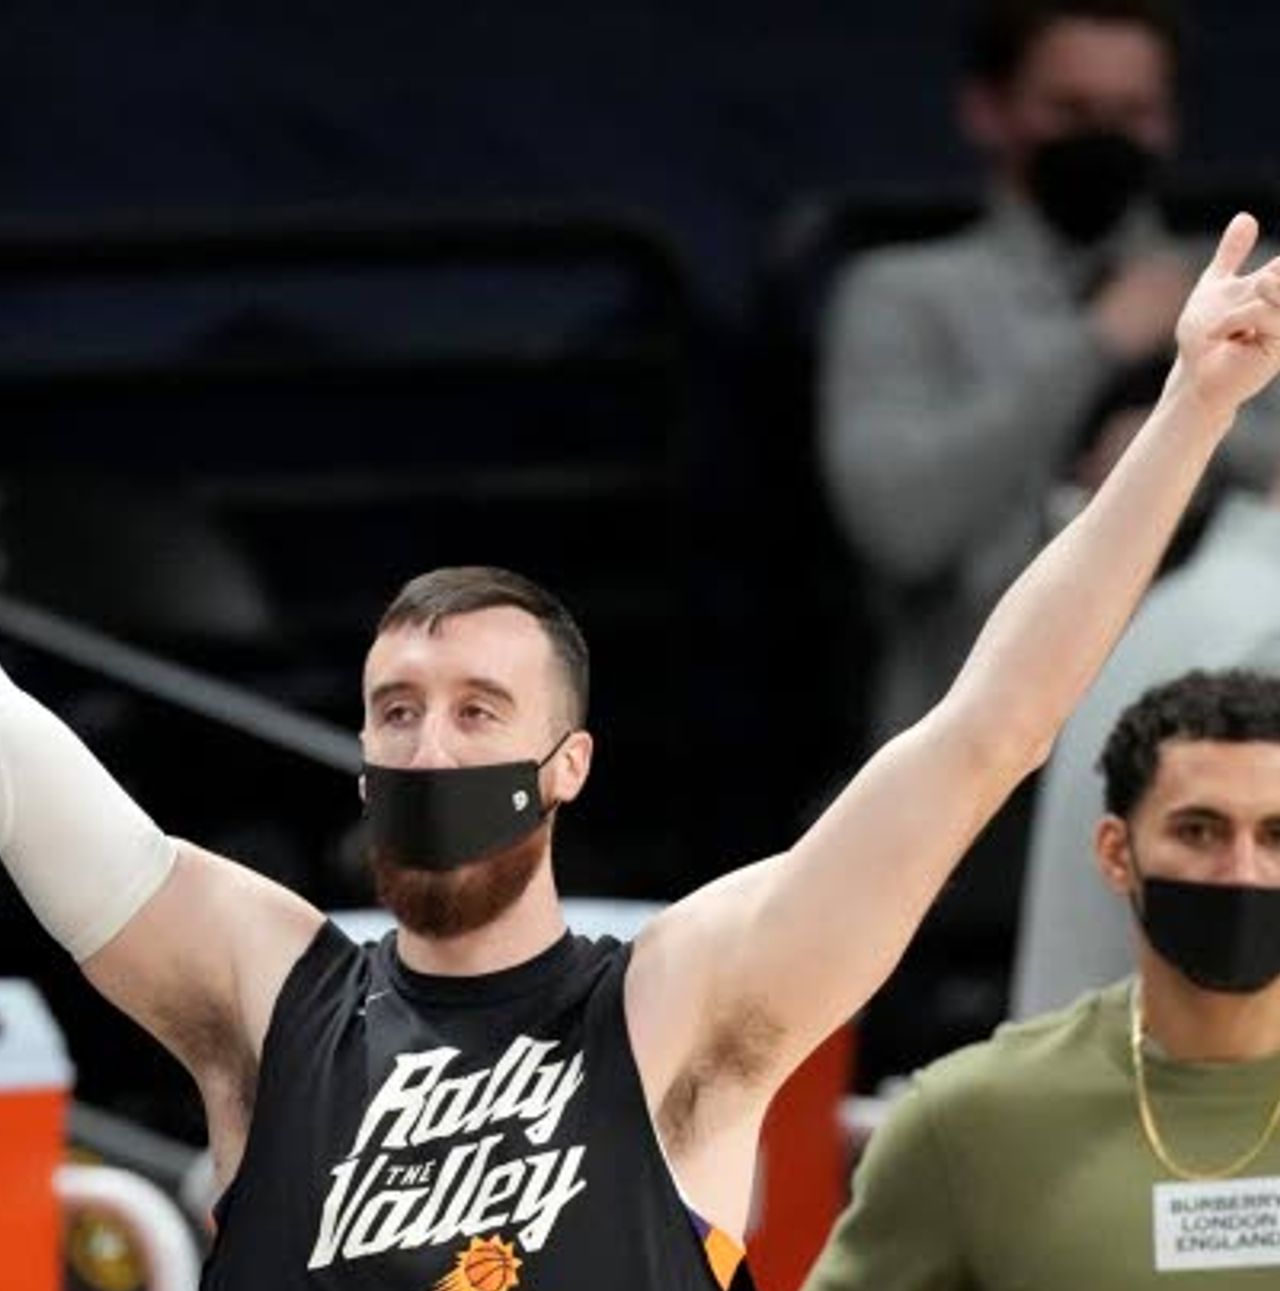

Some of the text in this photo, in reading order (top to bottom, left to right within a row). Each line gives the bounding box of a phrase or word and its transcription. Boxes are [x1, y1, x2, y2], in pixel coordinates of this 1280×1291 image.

[349, 1034, 585, 1158] Rally
[307, 1133, 587, 1270] Valley
[386, 1159, 436, 1186] THE
[1181, 1213, 1278, 1233] LONDON
